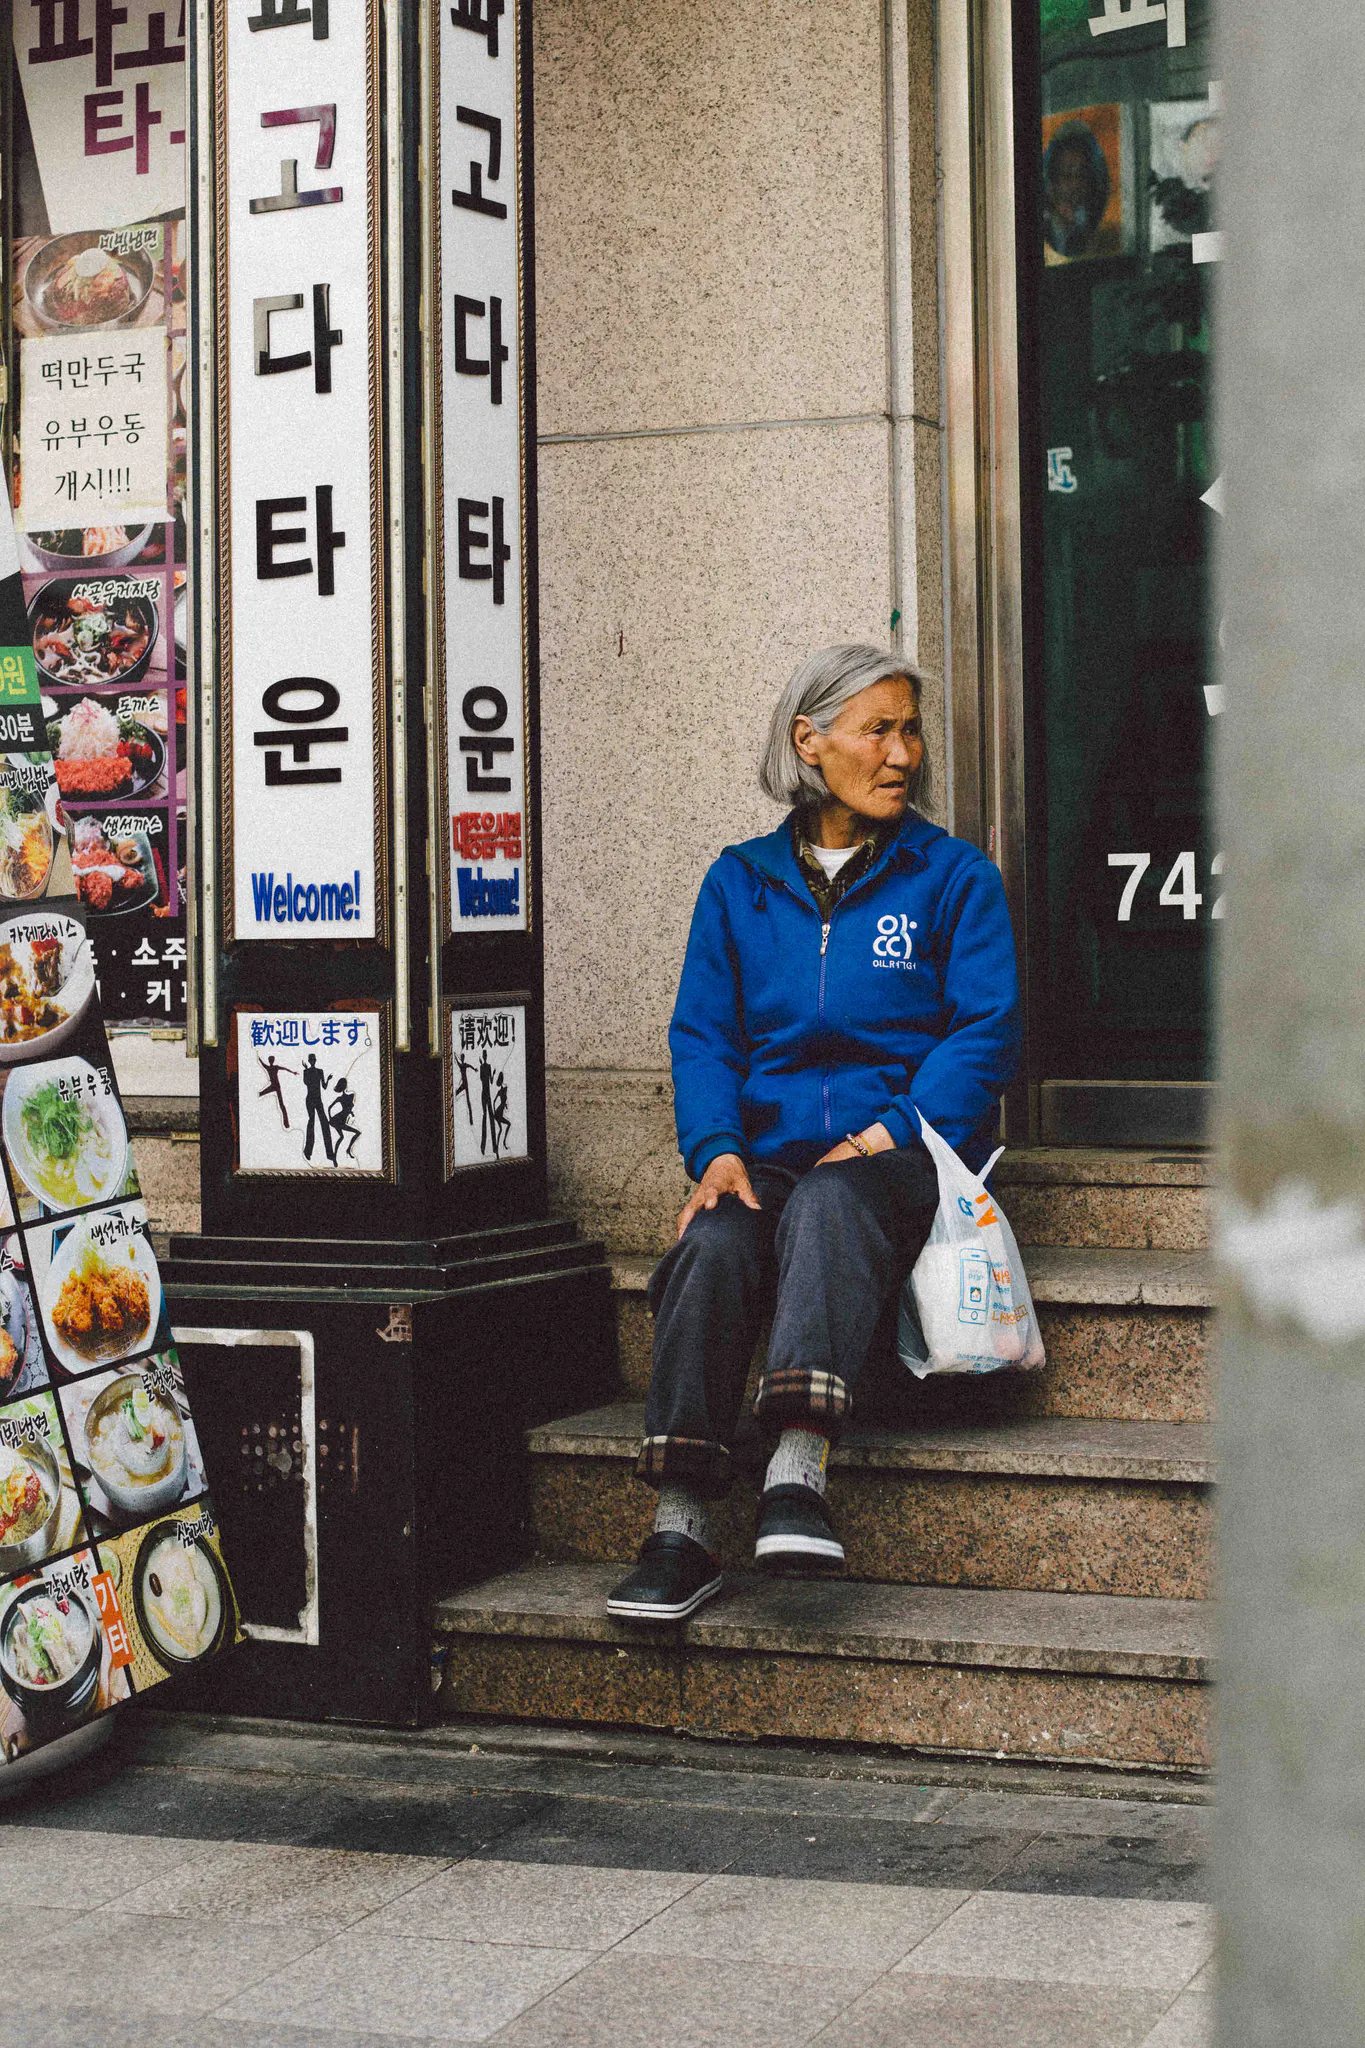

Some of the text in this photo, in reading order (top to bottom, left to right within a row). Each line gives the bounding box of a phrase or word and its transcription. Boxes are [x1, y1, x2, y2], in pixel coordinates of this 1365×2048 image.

[85, 82, 185, 175] 타
[100, 228, 158, 255] 비빔냉면
[42, 353, 145, 391] 떡만두국
[41, 413, 145, 451] 유부우동
[54, 467, 131, 501] 개시!!!
[72, 580, 161, 604] 사골우거지탕
[118, 697, 160, 720] 돈까스
[104, 816, 162, 837] 생선까스
[251, 870, 360, 922] Welcome!
[9, 918, 78, 943] 카레라이스
[131, 937, 186, 970] 소주
[146, 979, 187, 1012] 커
[58, 1068, 112, 1101] 유부우동
[90, 1216, 144, 1246] 생선까스
[142, 1367, 177, 1402] 물냉면
[177, 1511, 214, 1548] 삼계탕
[45, 1564, 89, 1602] 갈비탕
[96, 1576, 130, 1655] 기타
